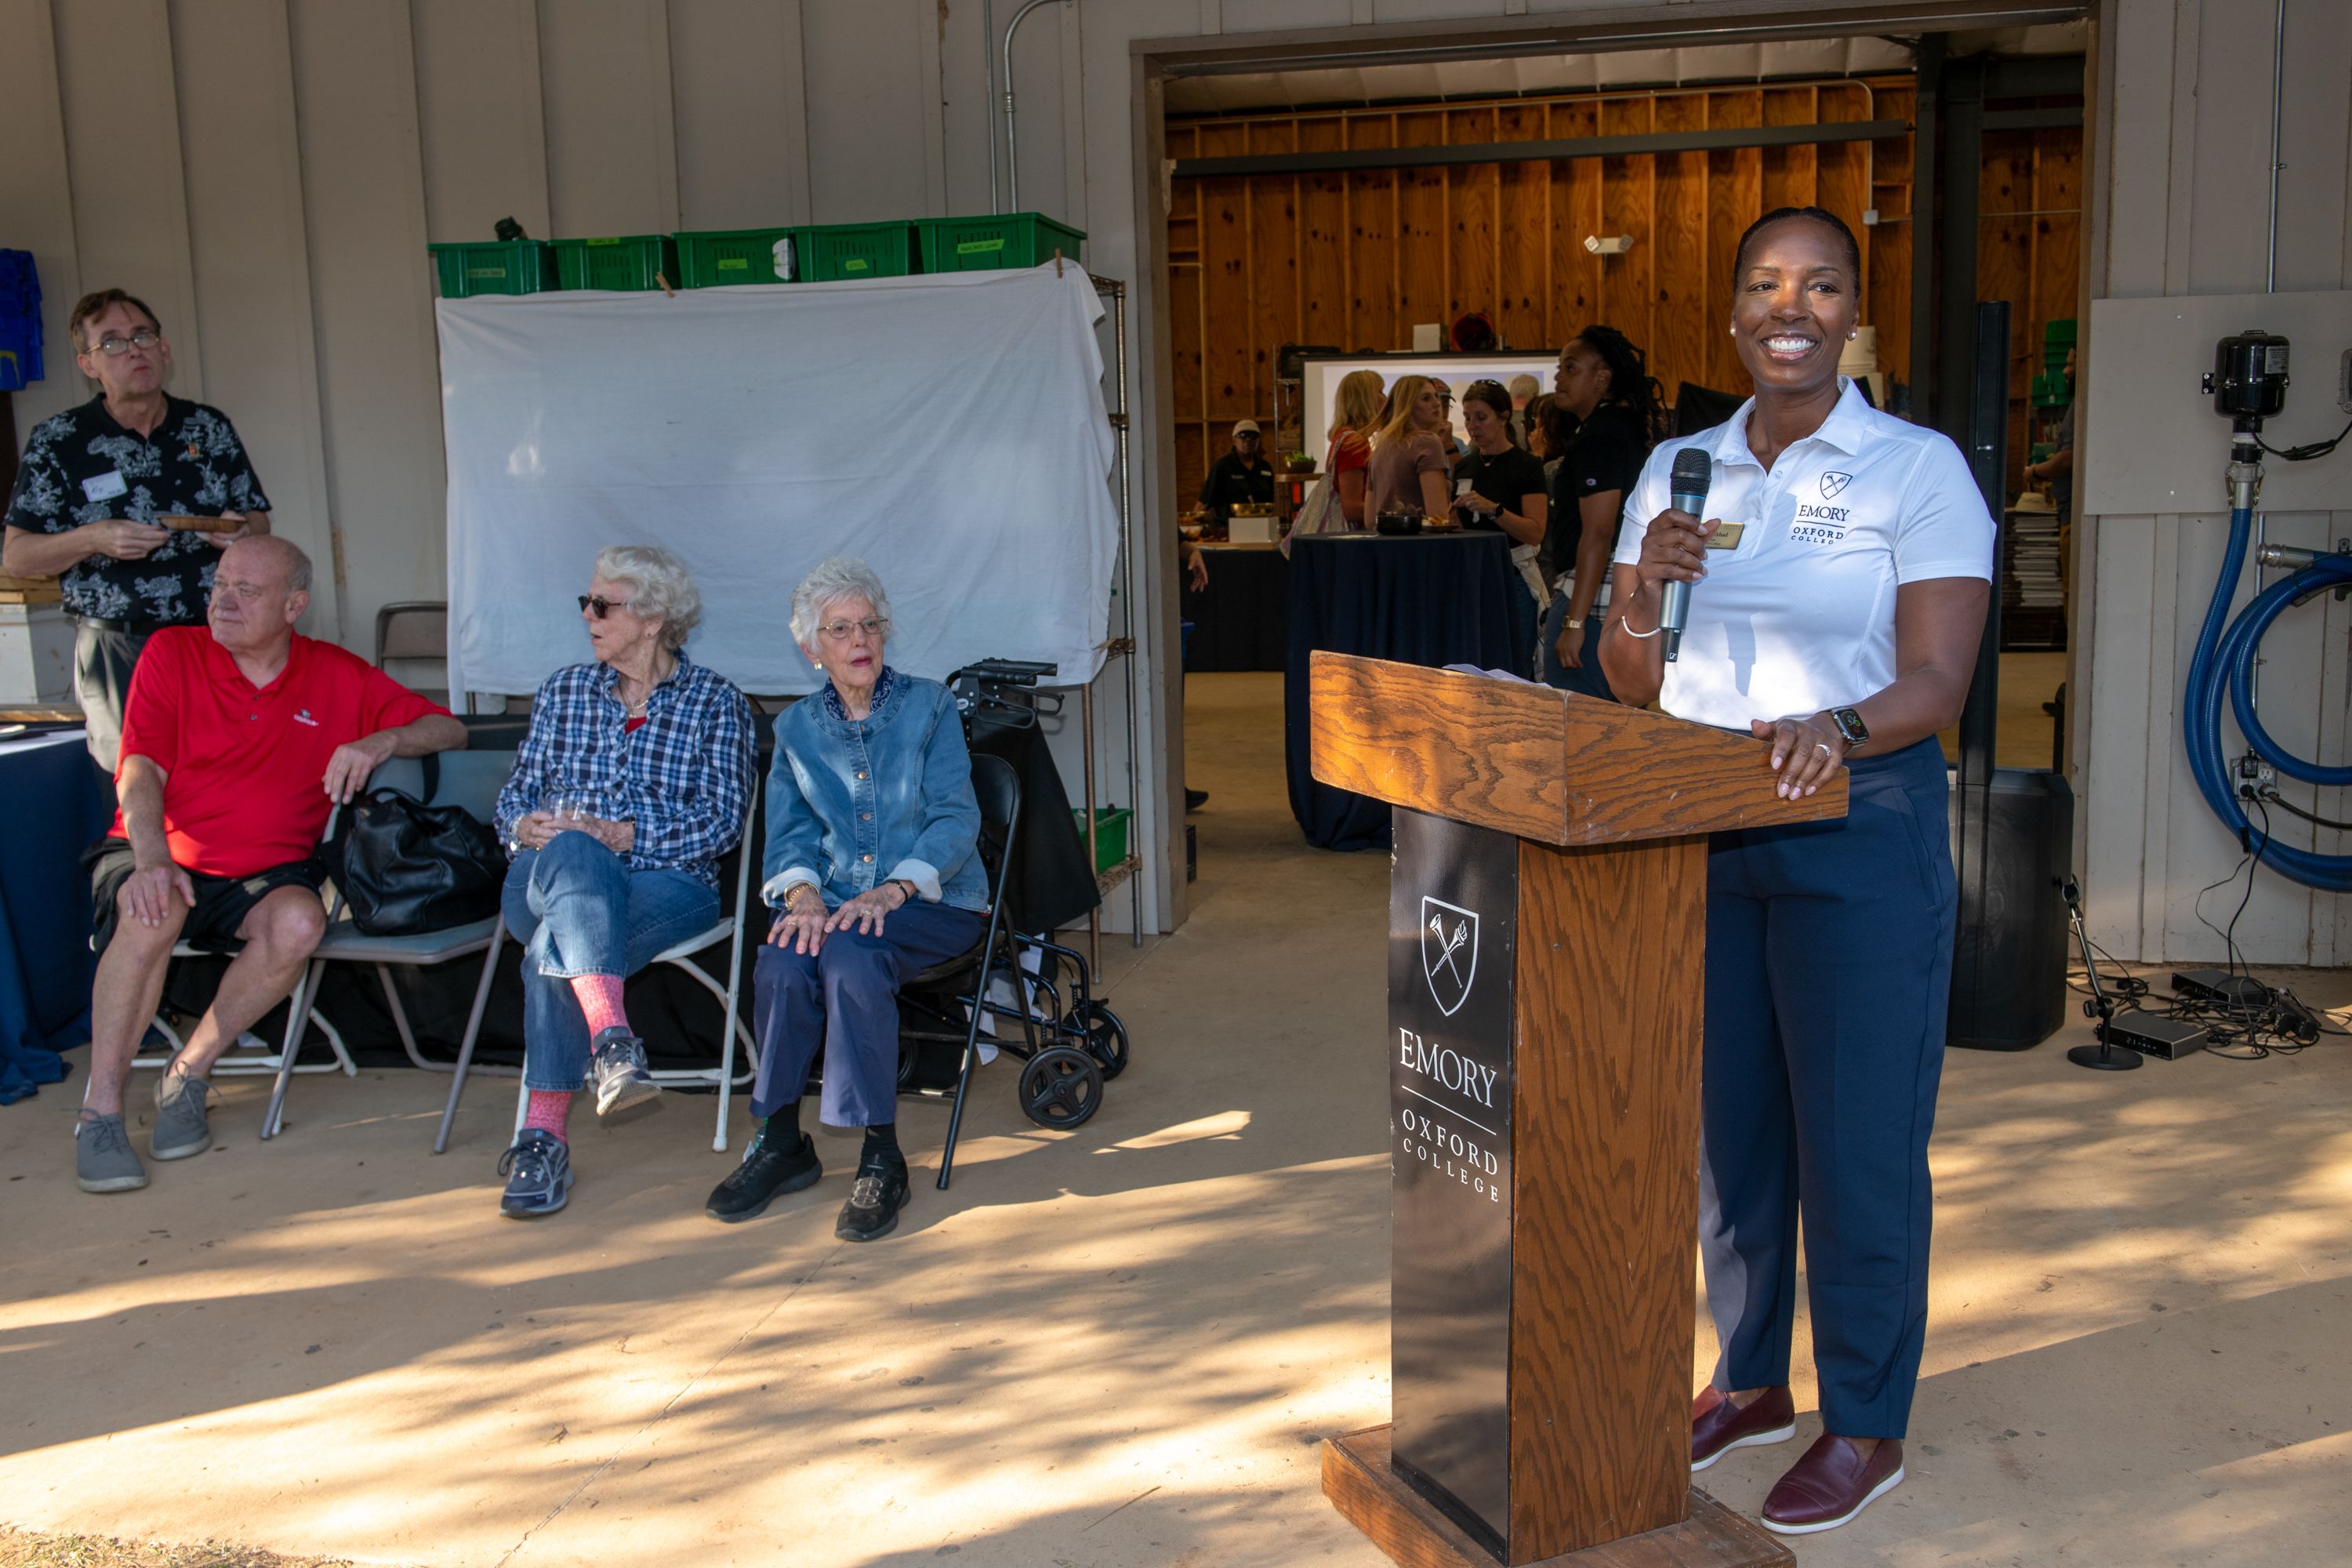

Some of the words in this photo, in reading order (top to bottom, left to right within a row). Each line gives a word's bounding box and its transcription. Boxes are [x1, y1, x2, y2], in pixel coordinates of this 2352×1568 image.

[1793, 527, 1844, 539] OXFORD
[1798, 505, 1850, 521] EMORY
[1791, 535, 1838, 545] COLLEG
[1399, 1028, 1497, 1108] EMORY
[1403, 1109, 1498, 1175] OXFORD
[1403, 1138, 1498, 1203] COLLEGE
